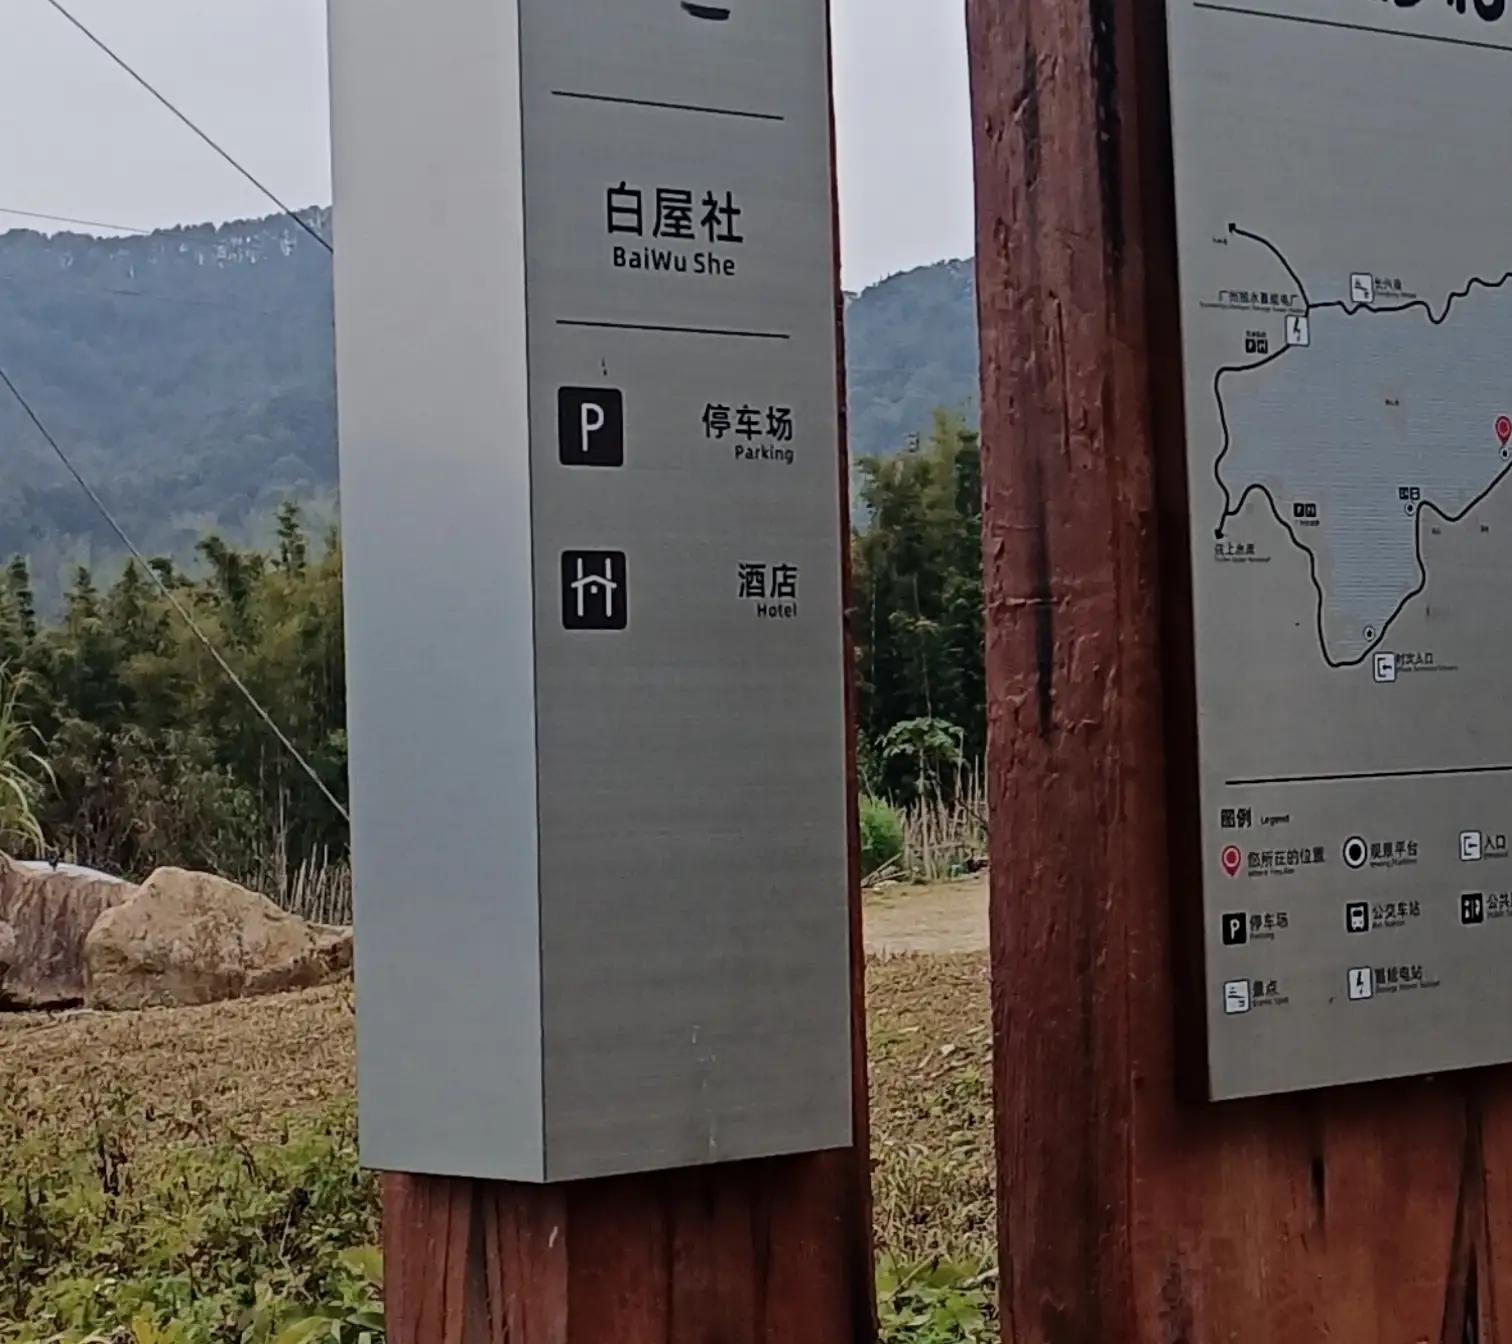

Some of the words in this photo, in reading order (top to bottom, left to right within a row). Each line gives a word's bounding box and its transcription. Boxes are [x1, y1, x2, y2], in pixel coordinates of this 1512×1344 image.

[606, 181, 744, 243] 白屋社
[613, 246, 687, 272] BaiWu
[693, 252, 735, 276] She
[702, 403, 793, 441] 停车场
[735, 445, 794, 465] Parking
[738, 563, 798, 598] 酒店
[757, 604, 797, 618] Hotel
[1221, 807, 1251, 828] 图例
[1485, 835, 1506, 850] 入口
